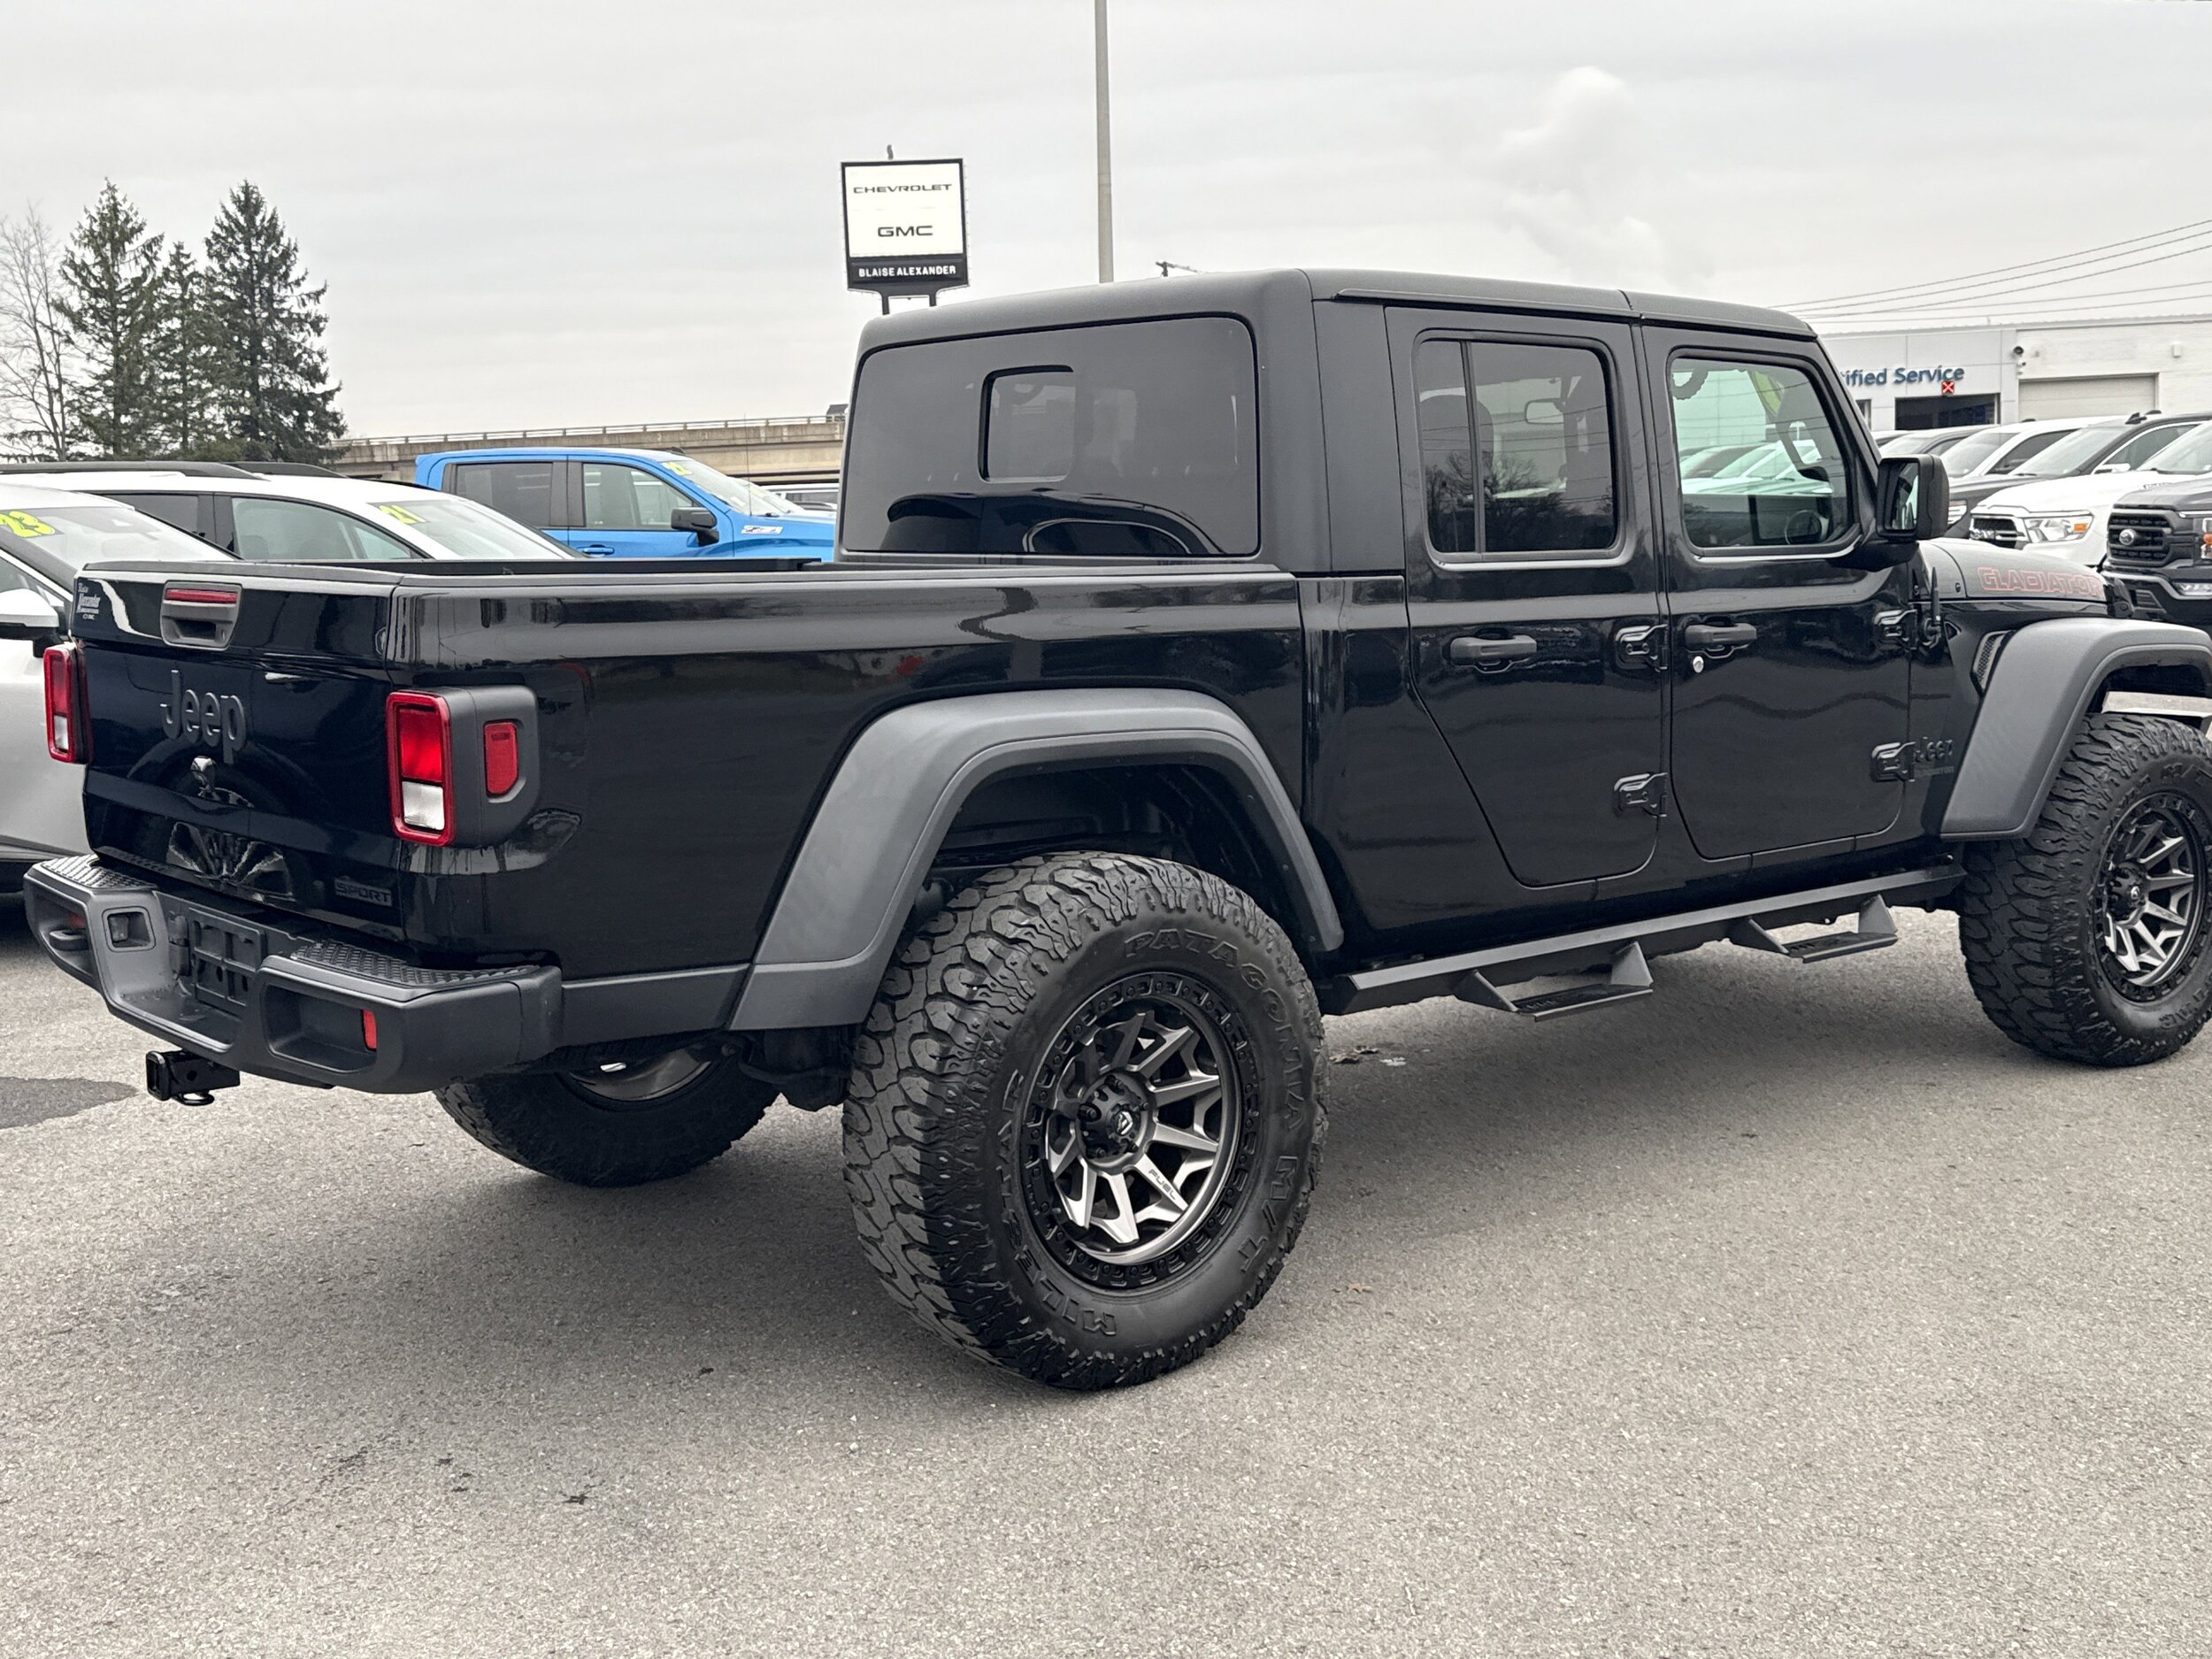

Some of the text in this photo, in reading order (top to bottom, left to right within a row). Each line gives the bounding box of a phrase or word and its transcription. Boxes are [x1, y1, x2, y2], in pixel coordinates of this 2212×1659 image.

[853, 183, 952, 194] CHEVROLET
[877, 225, 933, 237] GMC
[858, 265, 956, 277] BLAISE ALEXANDER
[1840, 365, 1965, 387] ified Service
[1977, 566, 2105, 597] GLADIATOR
[160, 669, 248, 764] Jeep
[335, 882, 391, 902] SPORT
[1124, 928, 1305, 1273] PATAGONIA M/T
[1148, 1168, 1176, 1201] FUEL
